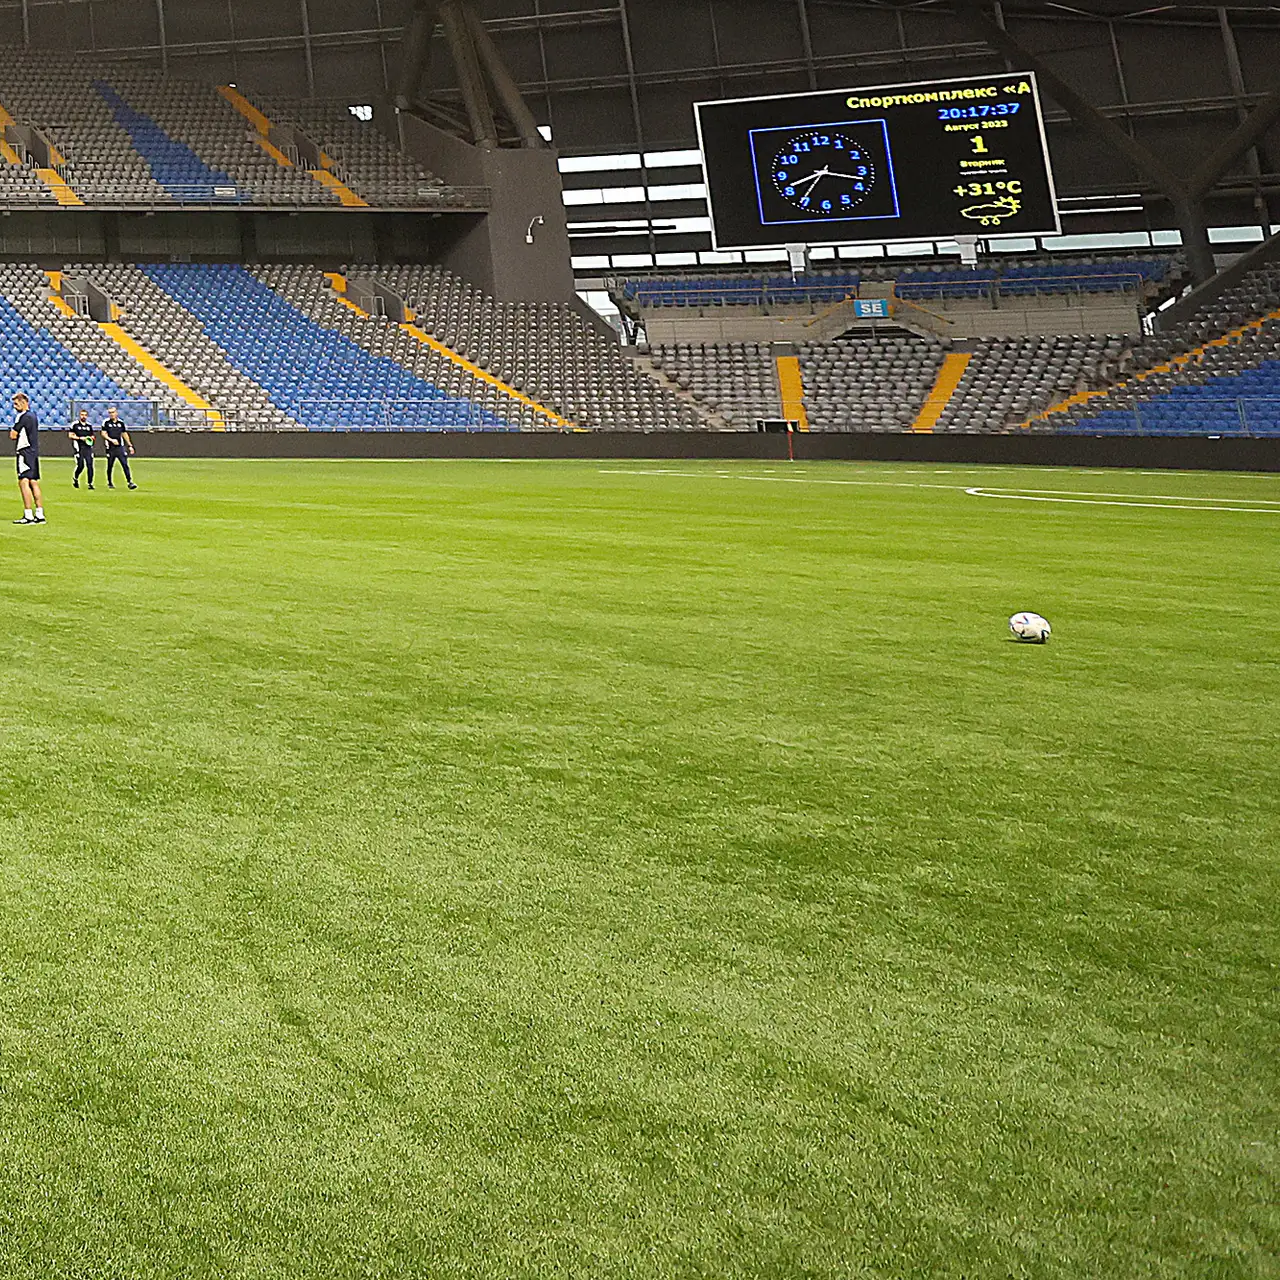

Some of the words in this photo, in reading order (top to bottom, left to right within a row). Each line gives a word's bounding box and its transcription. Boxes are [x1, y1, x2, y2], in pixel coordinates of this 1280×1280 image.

[846, 87, 998, 109] Спорткомплекс
[938, 103, 1020, 120] 20:17:37
[944, 122, 980, 132] Август
[981, 120, 1008, 129] 2023
[812, 136, 830, 146] 12
[834, 140, 844, 149] 1
[970, 135, 988, 153] 1
[793, 142, 811, 152] 11
[780, 154, 798, 165] 10
[849, 150, 860, 160] 2
[777, 171, 788, 181] 9
[856, 166, 867, 176] 3
[784, 186, 795, 196] 8
[854, 182, 864, 192] 4
[801, 196, 811, 207] 7
[841, 194, 851, 204] 5
[821, 200, 832, 210] 6
[860, 303, 883, 314] SE
